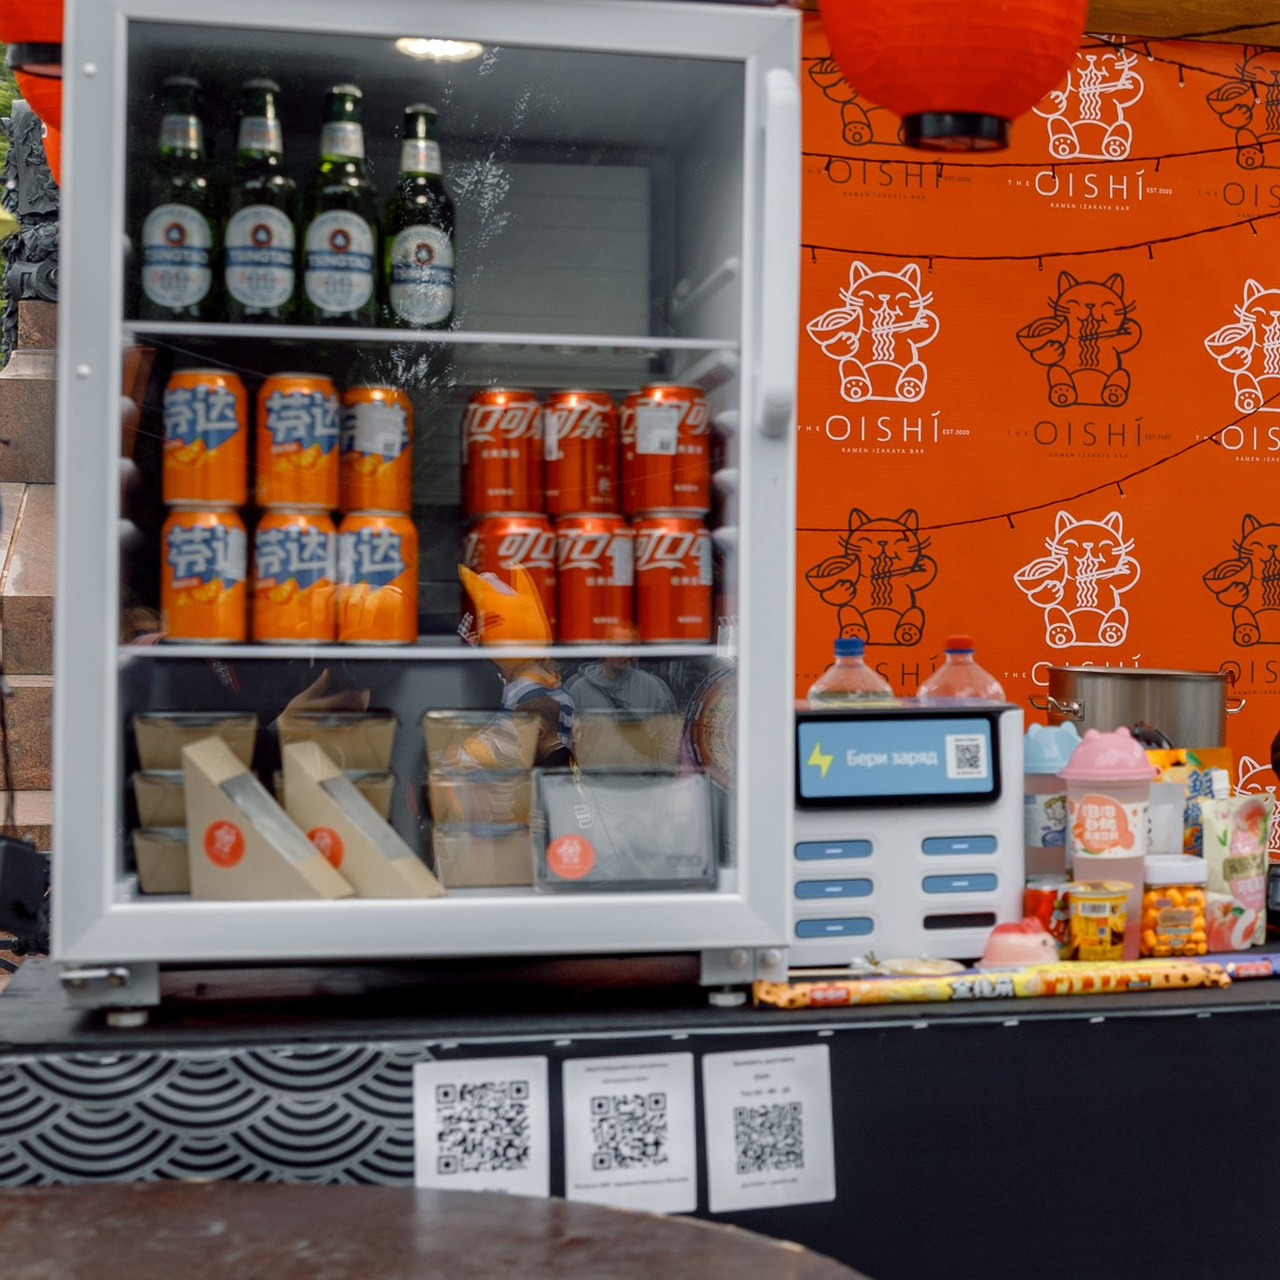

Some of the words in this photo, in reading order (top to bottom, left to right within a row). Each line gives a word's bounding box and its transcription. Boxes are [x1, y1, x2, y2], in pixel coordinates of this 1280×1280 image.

[1035, 169, 1145, 200] OISHÍ
[825, 410, 940, 443] OISHÍ
[1034, 416, 1143, 446] OISHÍ
[846, 749, 889, 768] Бери
[891, 751, 939, 767] заряд
